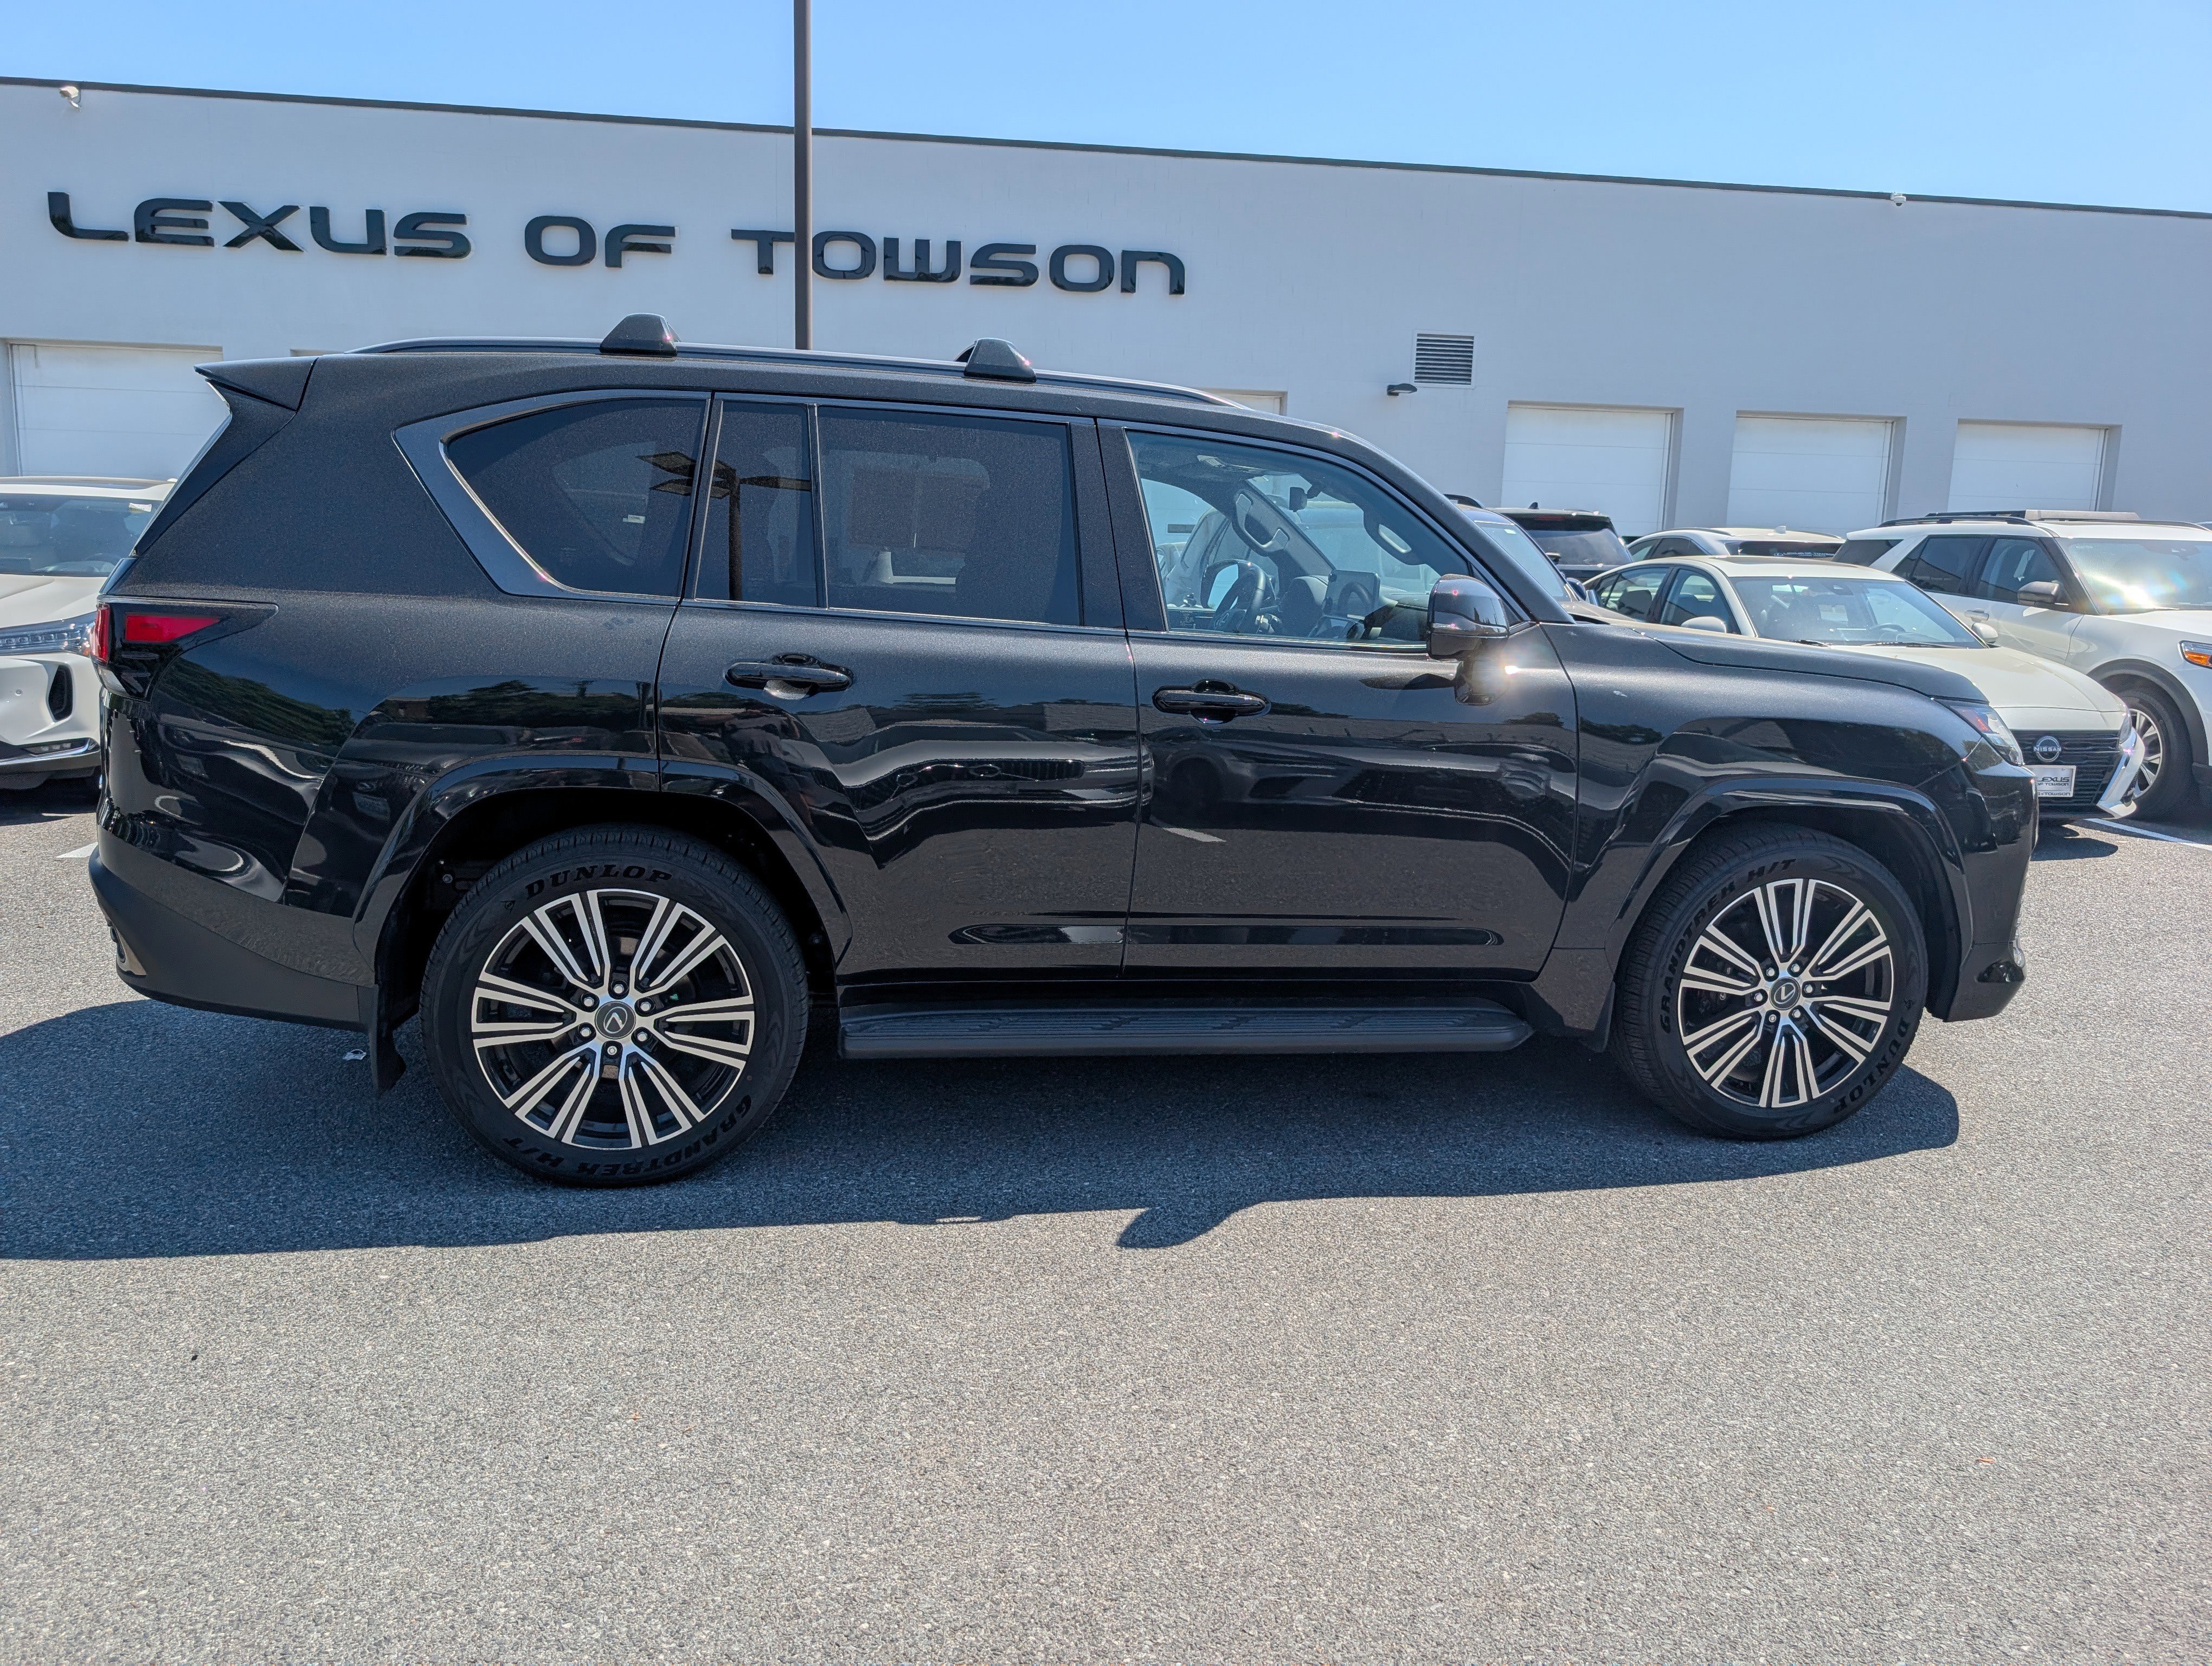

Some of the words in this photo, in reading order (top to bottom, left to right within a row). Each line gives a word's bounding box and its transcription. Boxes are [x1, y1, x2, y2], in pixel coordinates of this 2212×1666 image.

[48, 192, 472, 259] LEXUS
[524, 215, 676, 268] OF
[731, 228, 1185, 296] TOWSON
[525, 864, 672, 900] DUNLOP
[1660, 881, 1735, 1034] GRANDTREK
[1747, 858, 1797, 882] H/T
[1833, 1017, 1911, 1113] DUNLOP
[504, 1137, 565, 1168] H/T
[577, 1094, 753, 1176] GRANDTREK
